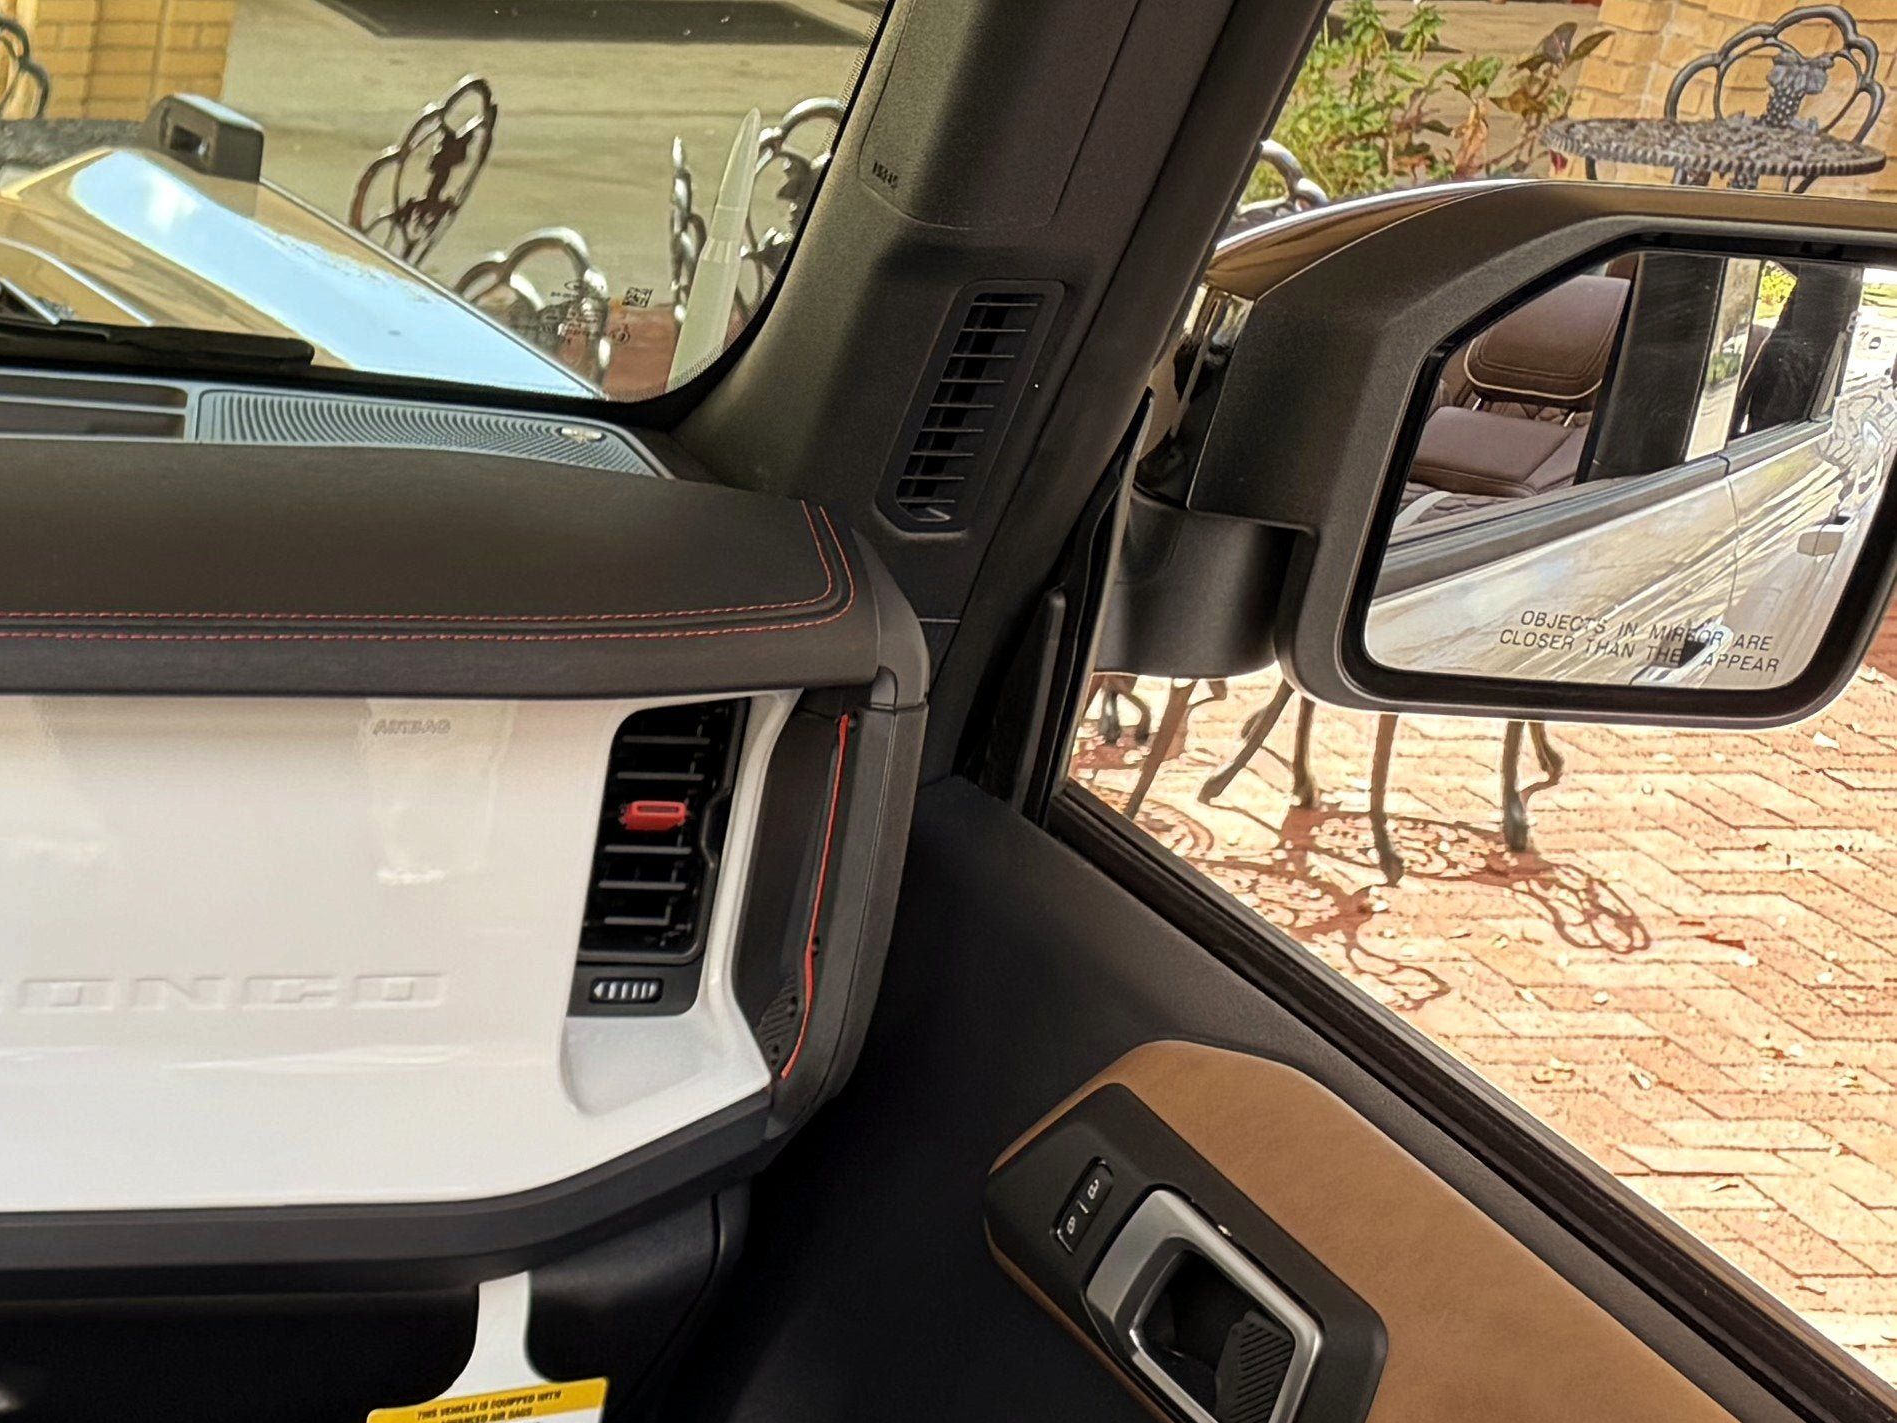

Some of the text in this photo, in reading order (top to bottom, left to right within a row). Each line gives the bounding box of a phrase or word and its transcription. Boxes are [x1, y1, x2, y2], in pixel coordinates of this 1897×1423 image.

[1499, 628, 1574, 651] CLOSER
[1584, 638, 1636, 660] THAN
[1704, 652, 1781, 674] APPEAR
[1520, 610, 1607, 634] OBJECTS
[1618, 622, 1637, 637] IN
[1734, 634, 1774, 652] ARE
